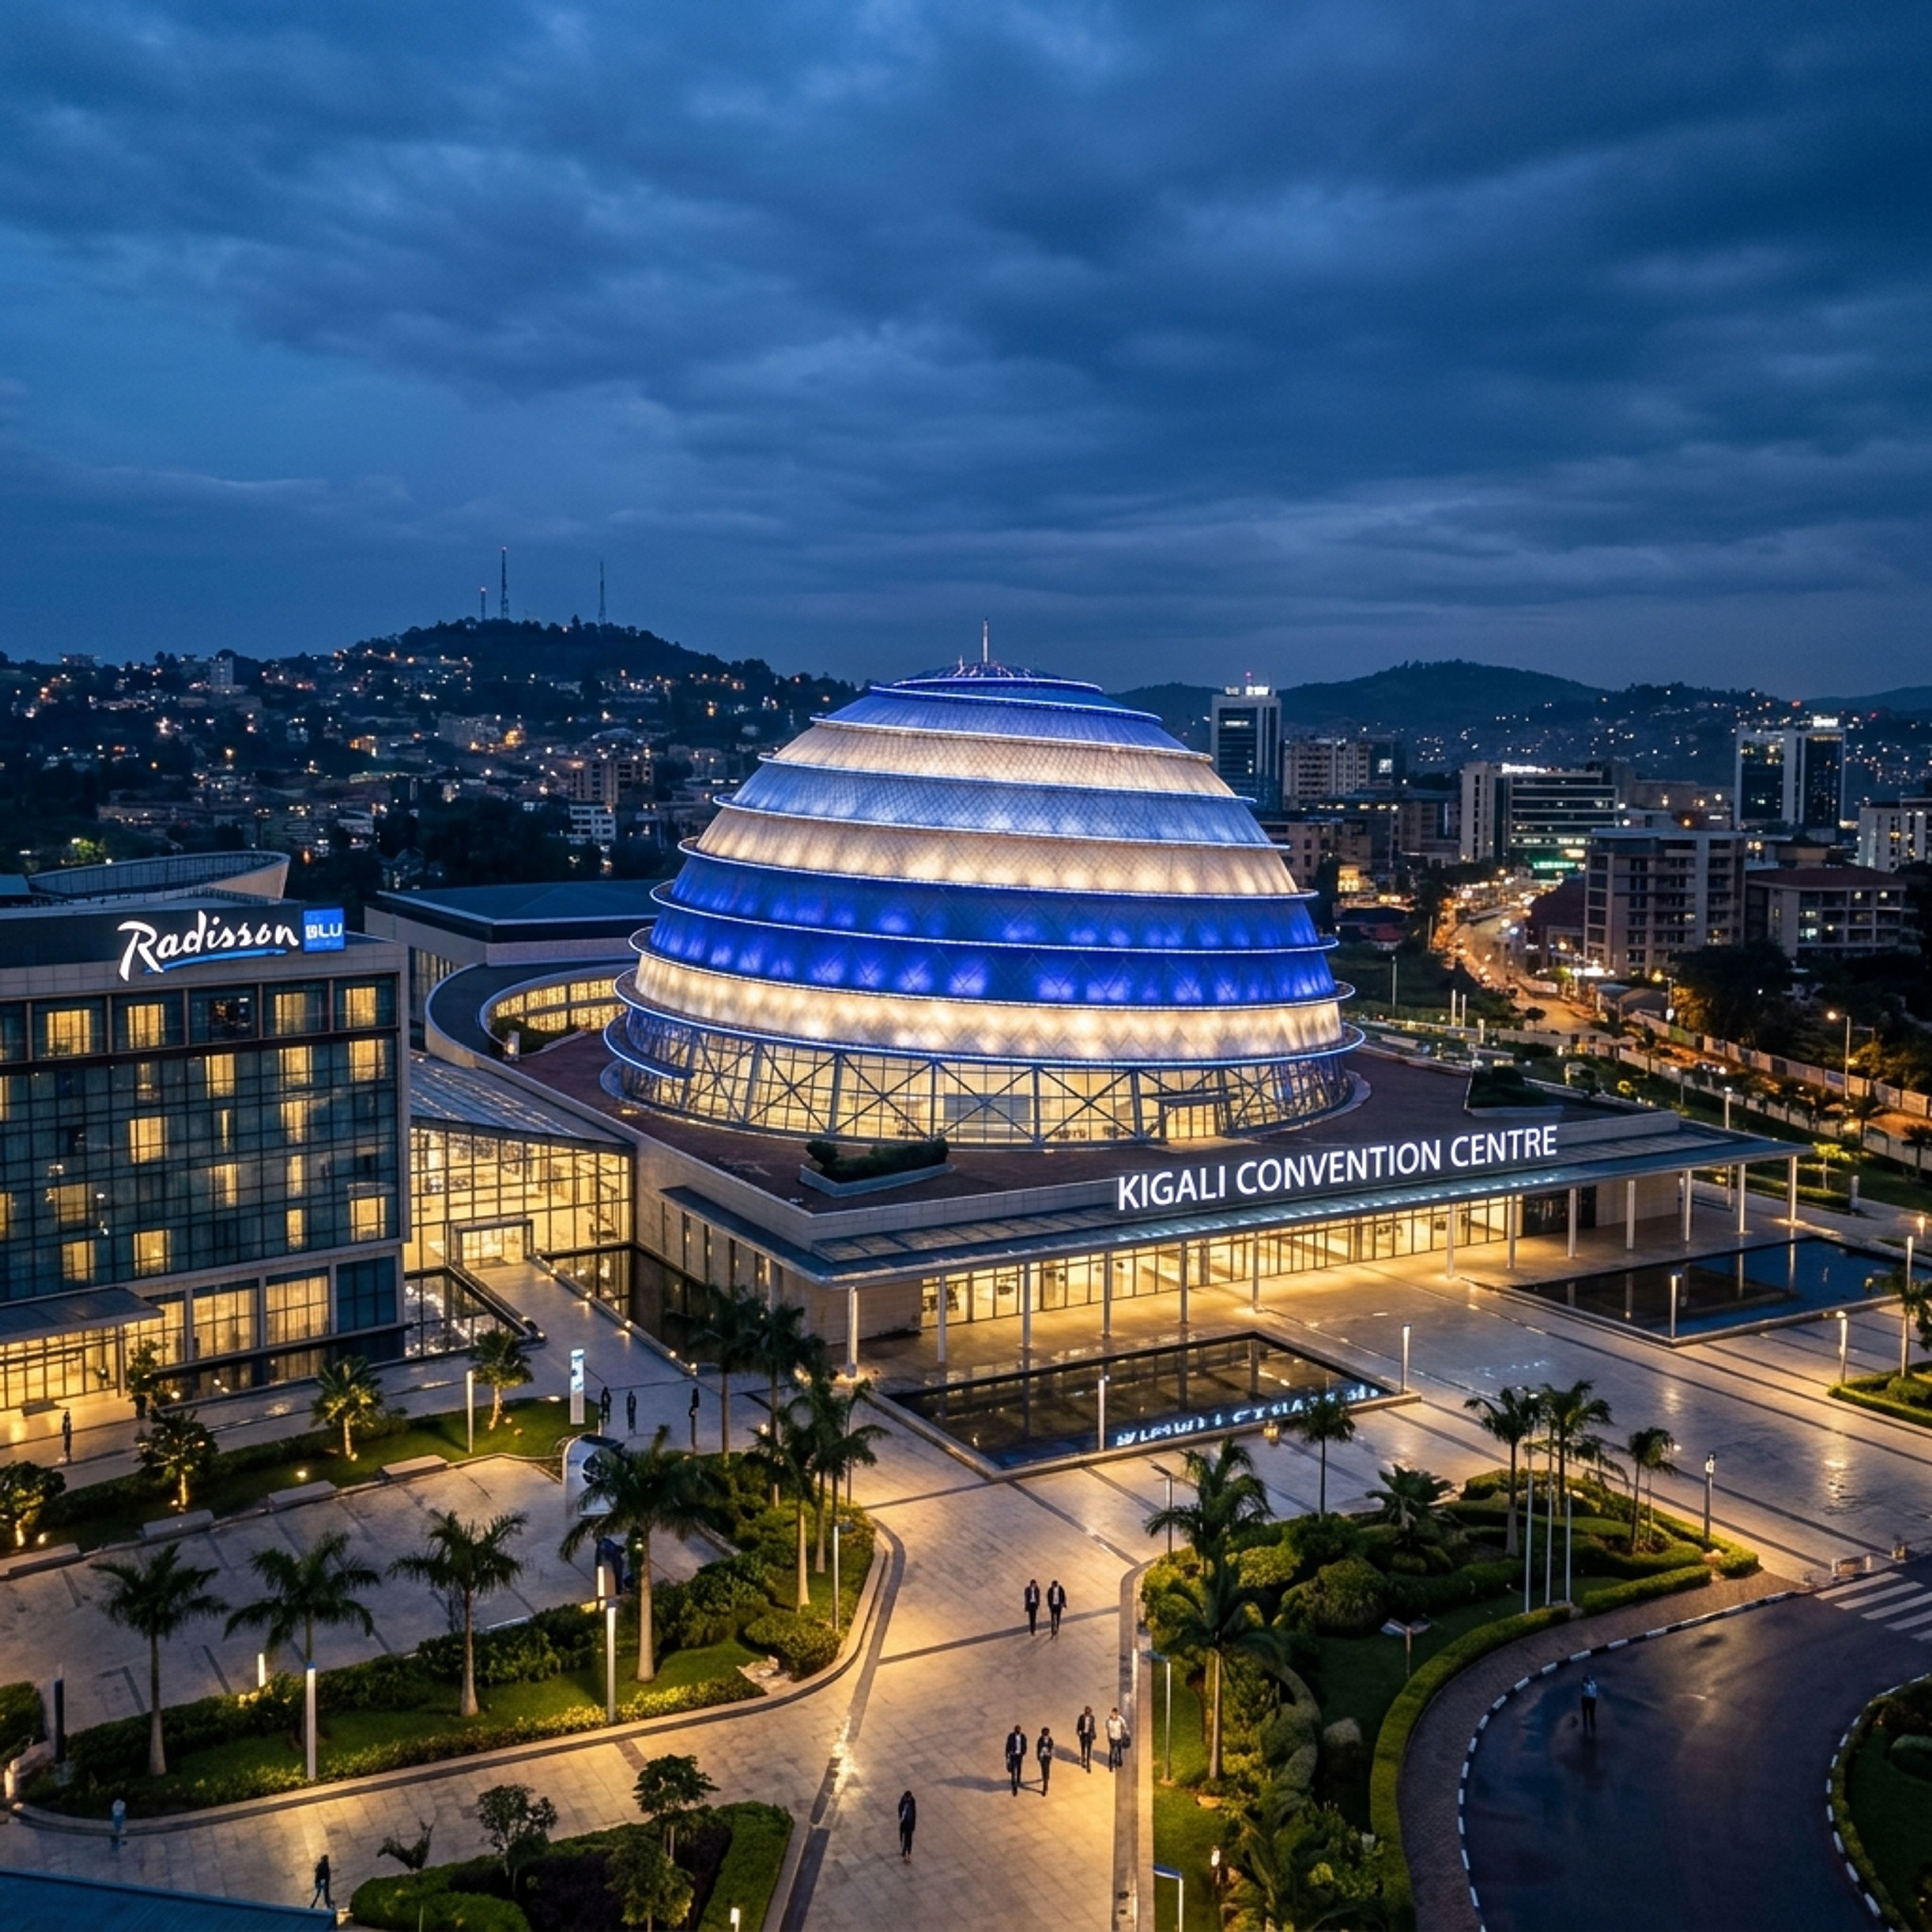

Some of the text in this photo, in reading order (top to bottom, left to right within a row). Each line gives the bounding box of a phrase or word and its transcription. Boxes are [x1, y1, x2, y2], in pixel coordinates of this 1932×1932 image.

[117, 910, 299, 982] Radisson
[1118, 1125, 1558, 1211] KIGALI CONVENTION CENTRE
